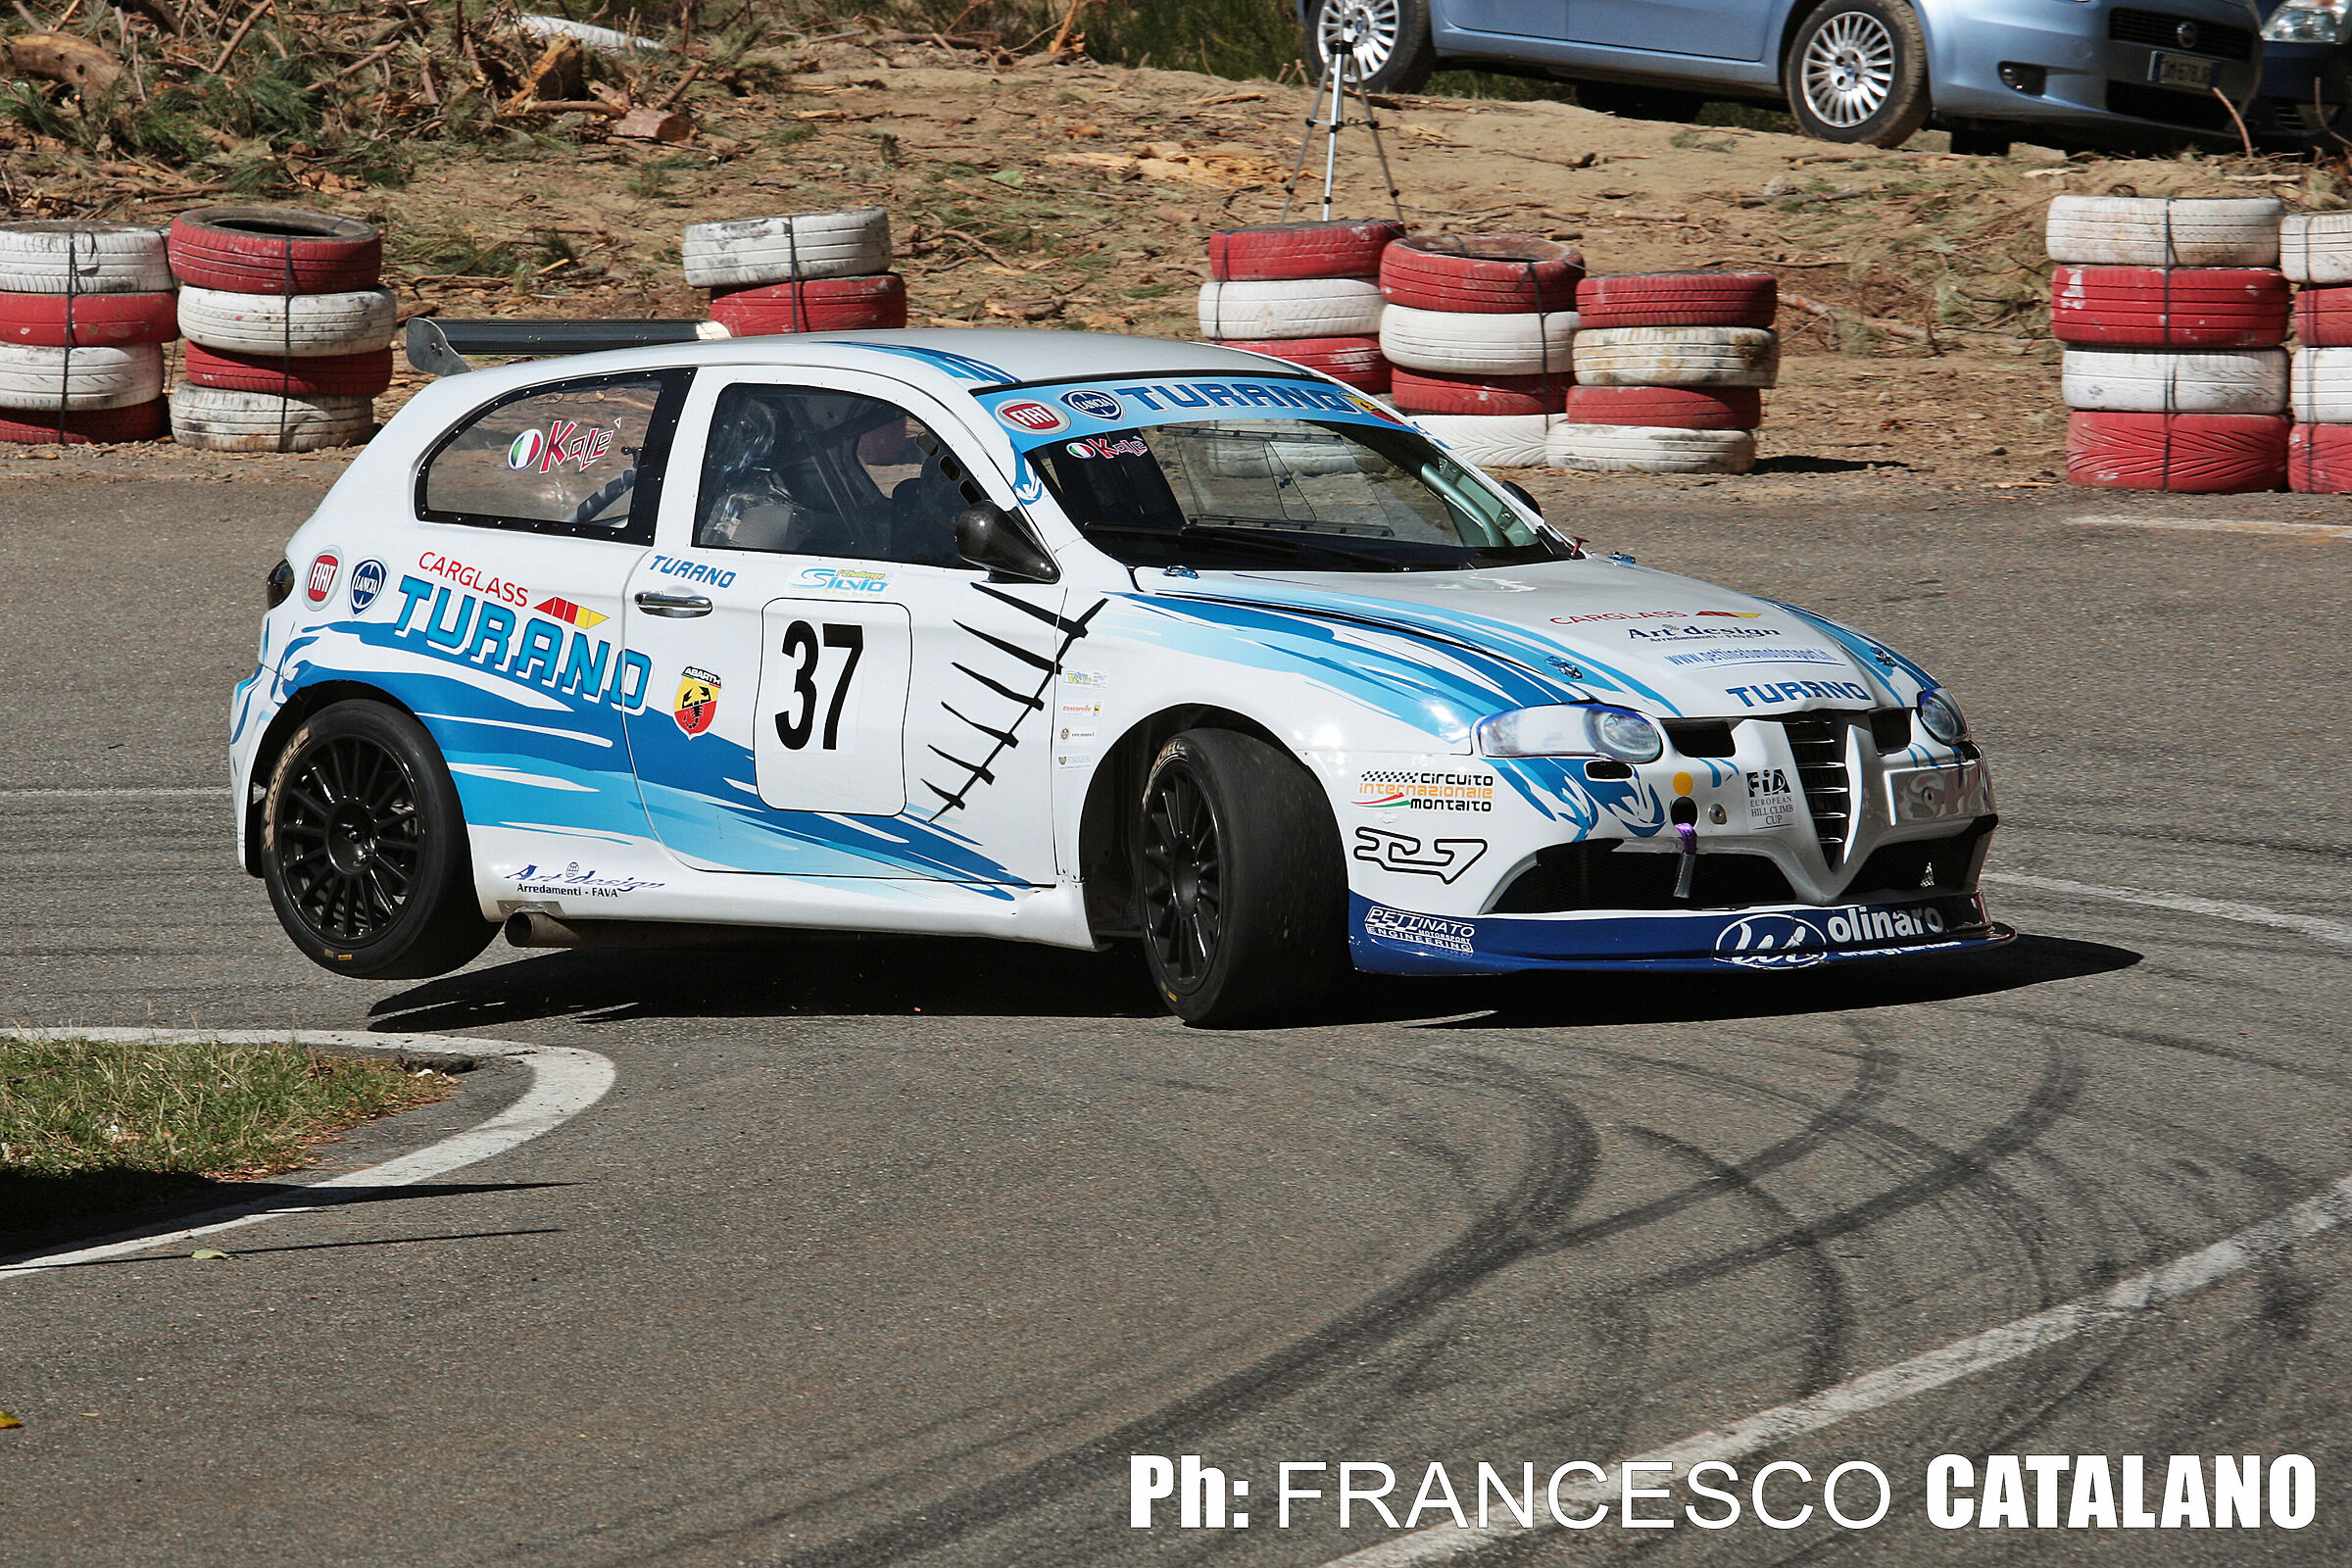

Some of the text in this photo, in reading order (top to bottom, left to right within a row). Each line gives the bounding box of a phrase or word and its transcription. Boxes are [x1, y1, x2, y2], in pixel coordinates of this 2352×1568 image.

[1075, 398, 1113, 411] LANCIA
[1113, 383, 1361, 416] TURANO
[1009, 403, 1054, 428] FIAT
[309, 562, 337, 593] FIAT
[418, 551, 529, 608] CARGLASS
[649, 555, 737, 589] TURANO
[355, 575, 378, 595] LANCIA
[1548, 610, 1689, 625] CARGLASS
[1628, 625, 1783, 639] Art design
[393, 573, 655, 716] TURANO
[684, 667, 721, 685] ABARTH
[774, 619, 864, 751] 37
[1725, 680, 1873, 708] TURANO
[1359, 783, 1494, 799] internazionale
[1750, 796, 1792, 808] EUROPEAN
[1751, 805, 1794, 817] HILL CLIMB
[1765, 814, 1784, 825] CUP
[504, 863, 666, 893] Art design
[516, 883, 582, 897] Arredamenti
[592, 885, 618, 898] FAVA
[1369, 908, 1476, 938] PETTINATO
[1367, 925, 1472, 951] ENGINEERING
[1418, 928, 1471, 944] MOTORSPORT
